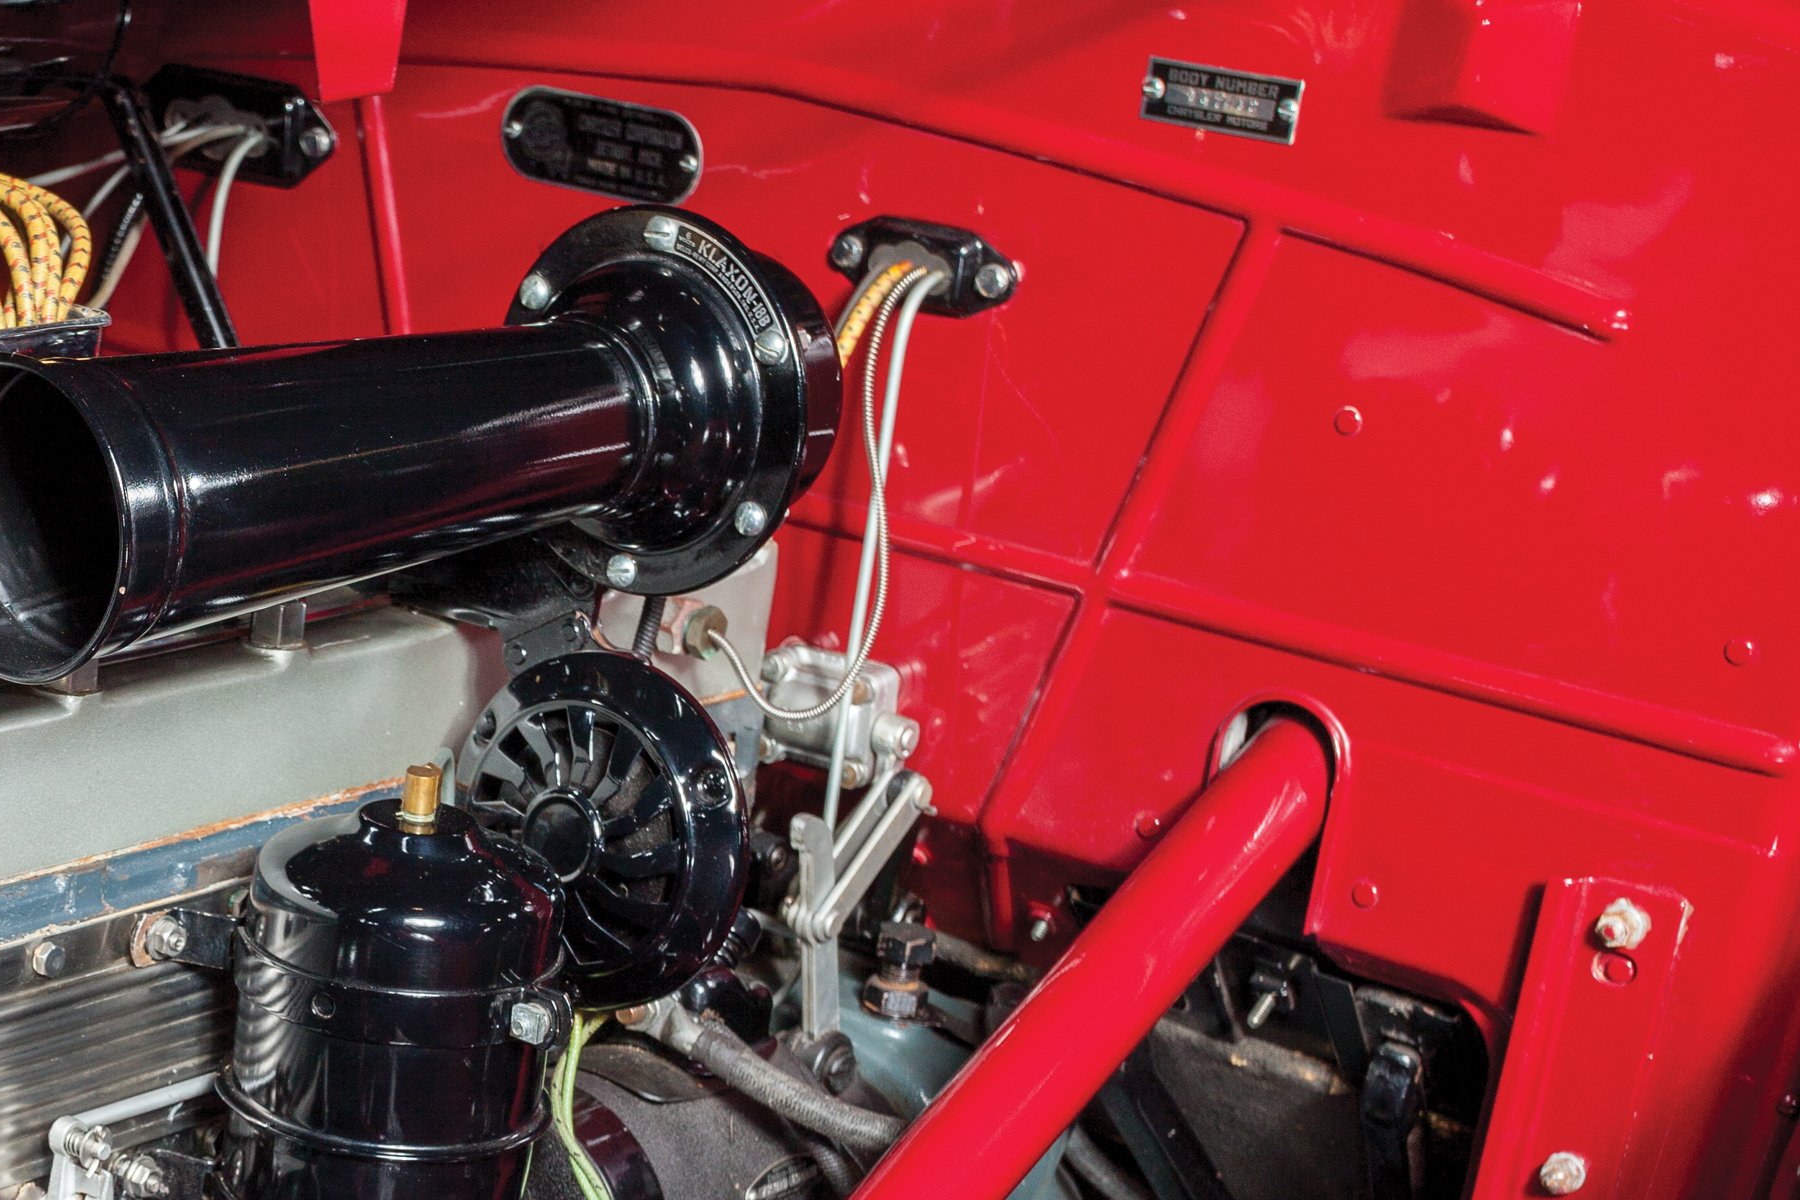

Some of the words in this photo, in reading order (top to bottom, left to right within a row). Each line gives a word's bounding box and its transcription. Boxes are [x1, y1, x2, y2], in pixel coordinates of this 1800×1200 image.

[1168, 67, 1210, 86] BODY
[1215, 75, 1280, 98] NUMBER
[698, 239, 771, 328] KLAXON-18B
